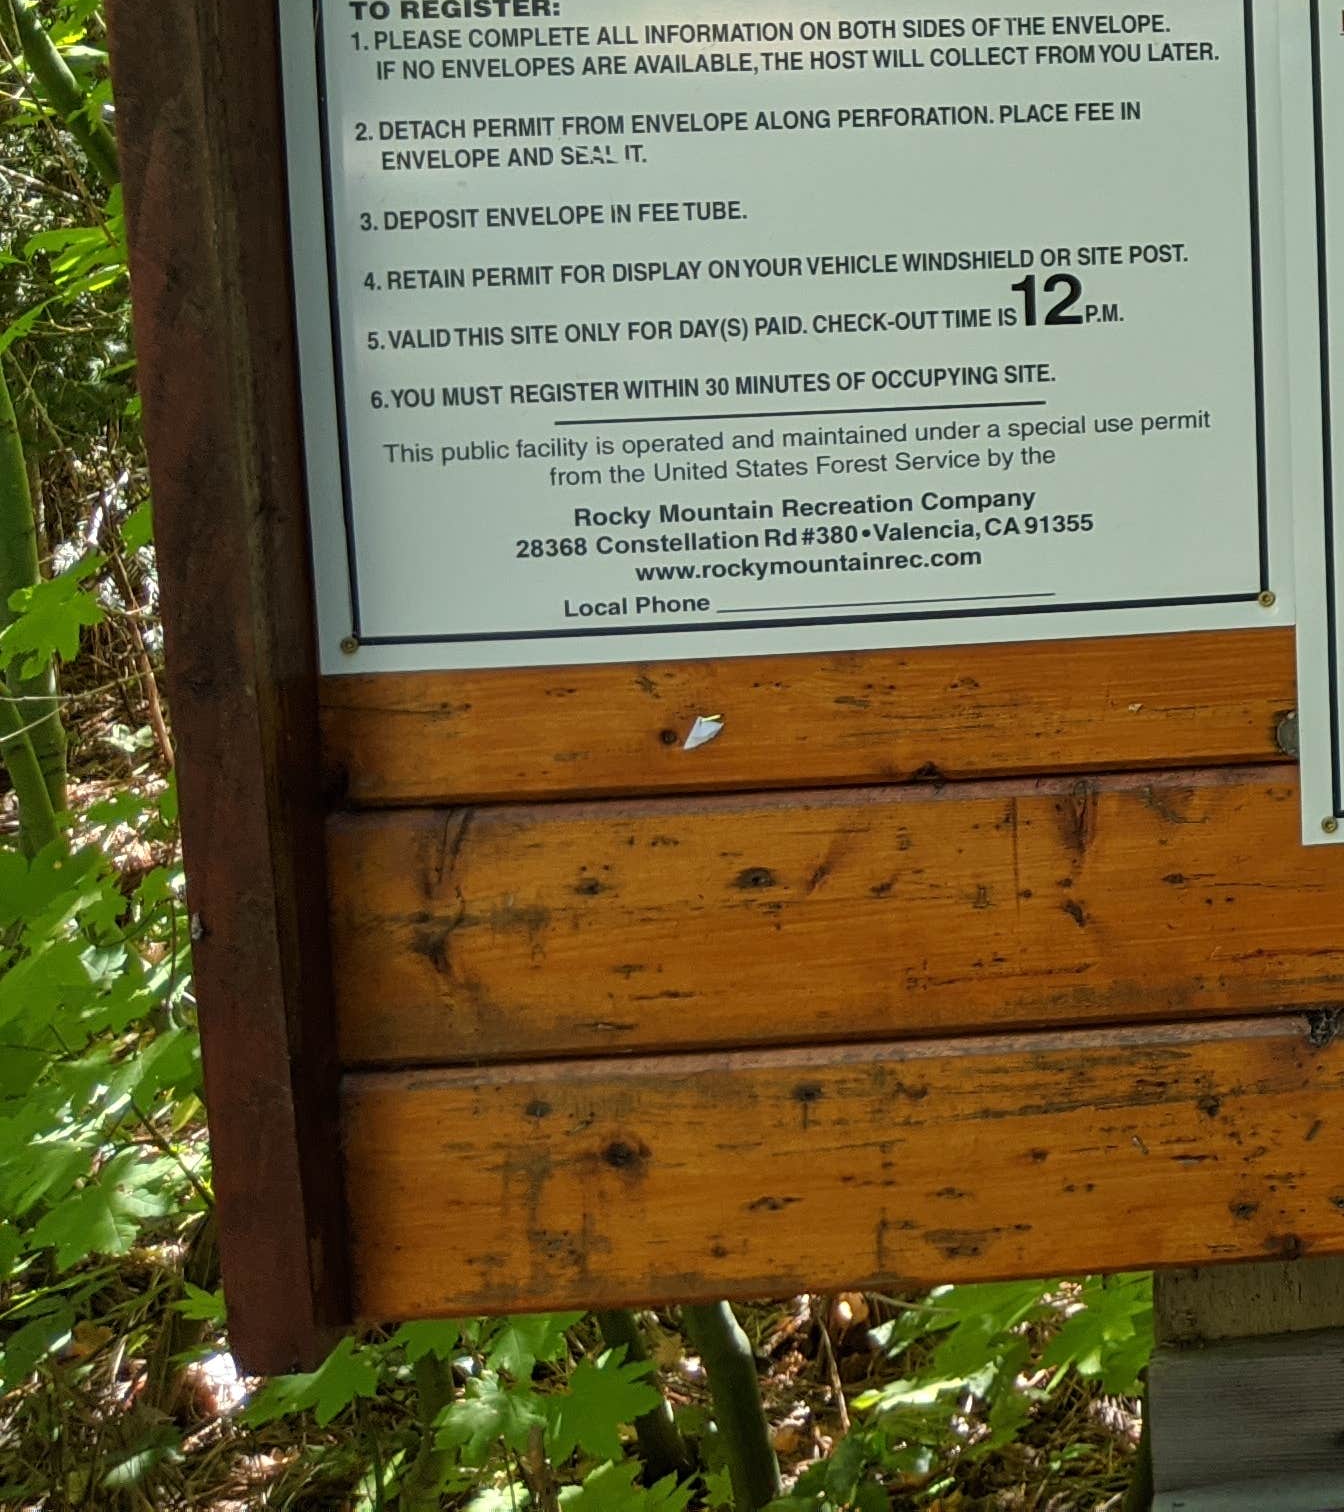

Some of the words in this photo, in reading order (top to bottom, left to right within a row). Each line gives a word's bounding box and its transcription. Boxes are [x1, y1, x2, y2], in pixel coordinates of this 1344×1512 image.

[349, 1, 389, 20] TO
[361, 213, 378, 231] 3.
[384, 209, 479, 230] DEPOSIT
[487, 205, 604, 227] ENVELOPE
[611, 204, 631, 223] IN
[639, 203, 679, 222] FEE
[683, 201, 747, 220] TUBE.
[575, 507, 651, 529] Rocky
[660, 500, 773, 522] Mountain
[783, 495, 912, 517] Recreation
[922, 492, 1035, 513] Company
[635, 552, 981, 581] www.rockymountainrec.com
[565, 598, 627, 617] Local
[636, 596, 709, 613] Phone
